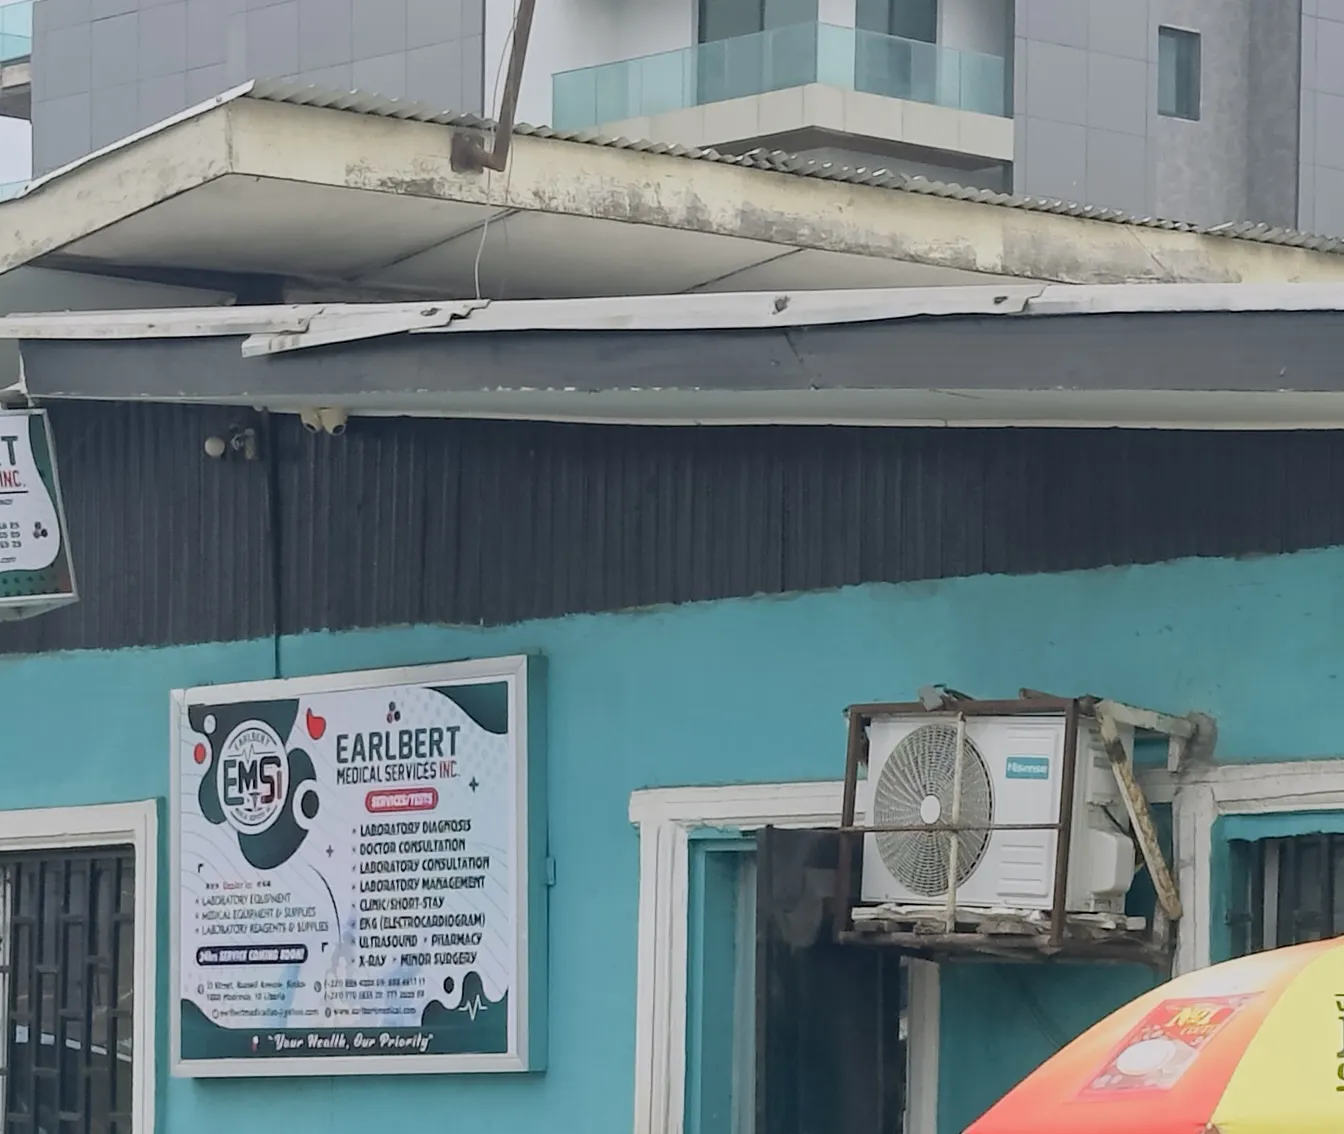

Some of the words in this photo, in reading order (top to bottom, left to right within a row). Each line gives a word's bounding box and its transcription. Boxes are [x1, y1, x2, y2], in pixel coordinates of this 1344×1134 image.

[336, 726, 461, 764] EARLBERT
[337, 765, 383, 785] MEDICAL
[384, 761, 437, 782] SERVICES
[359, 821, 421, 838] LABORATORY
[422, 818, 472, 834] DIAGNOSIS
[359, 841, 397, 856] DOCTOR
[398, 838, 466, 853] CONSULTATION
[359, 859, 420, 875] LABORATORY
[422, 855, 490, 872] CONSULTATION
[359, 877, 421, 893] LABORATORY
[421, 875, 486, 891] MANAGEMENT
[359, 917, 378, 931] EKG
[359, 934, 418, 949] ULTRASOUND
[431, 932, 483, 947] PHARMACY
[359, 954, 388, 969] X-RAY
[400, 952, 432, 967] MINOR
[434, 951, 478, 967] SURGERY
[353, 1032, 376, 1048] Our
